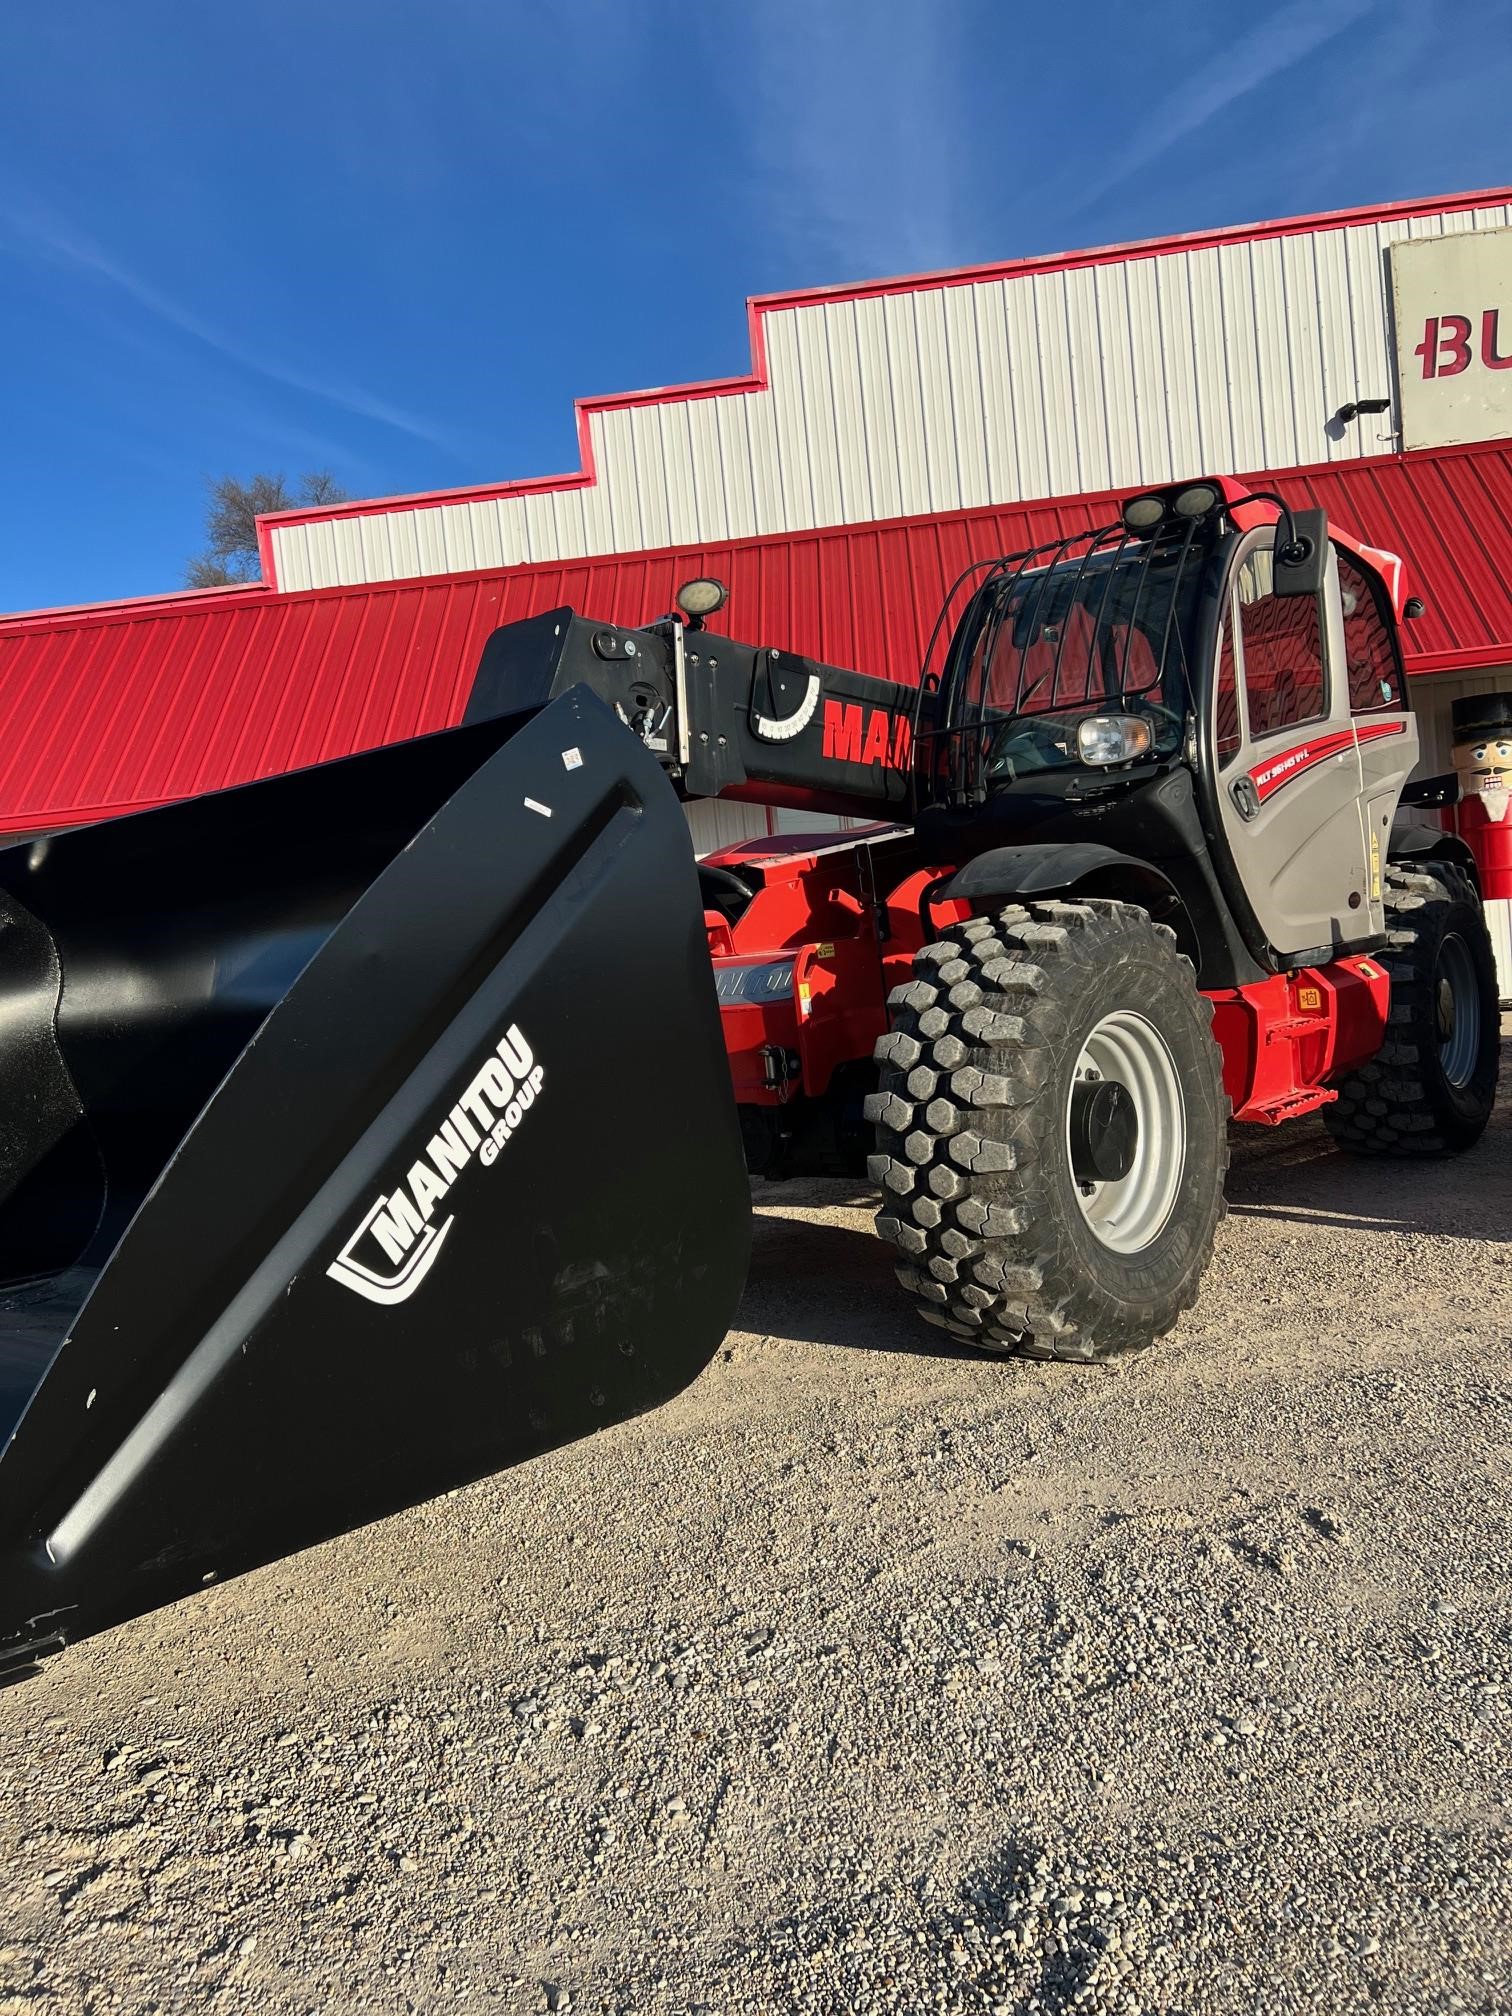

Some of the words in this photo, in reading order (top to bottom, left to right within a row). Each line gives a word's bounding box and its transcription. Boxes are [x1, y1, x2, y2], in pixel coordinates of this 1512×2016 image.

[1414, 308, 1512, 380] BU
[369, 1022, 535, 1267] MANITOU
[477, 1064, 545, 1168] GROUP
